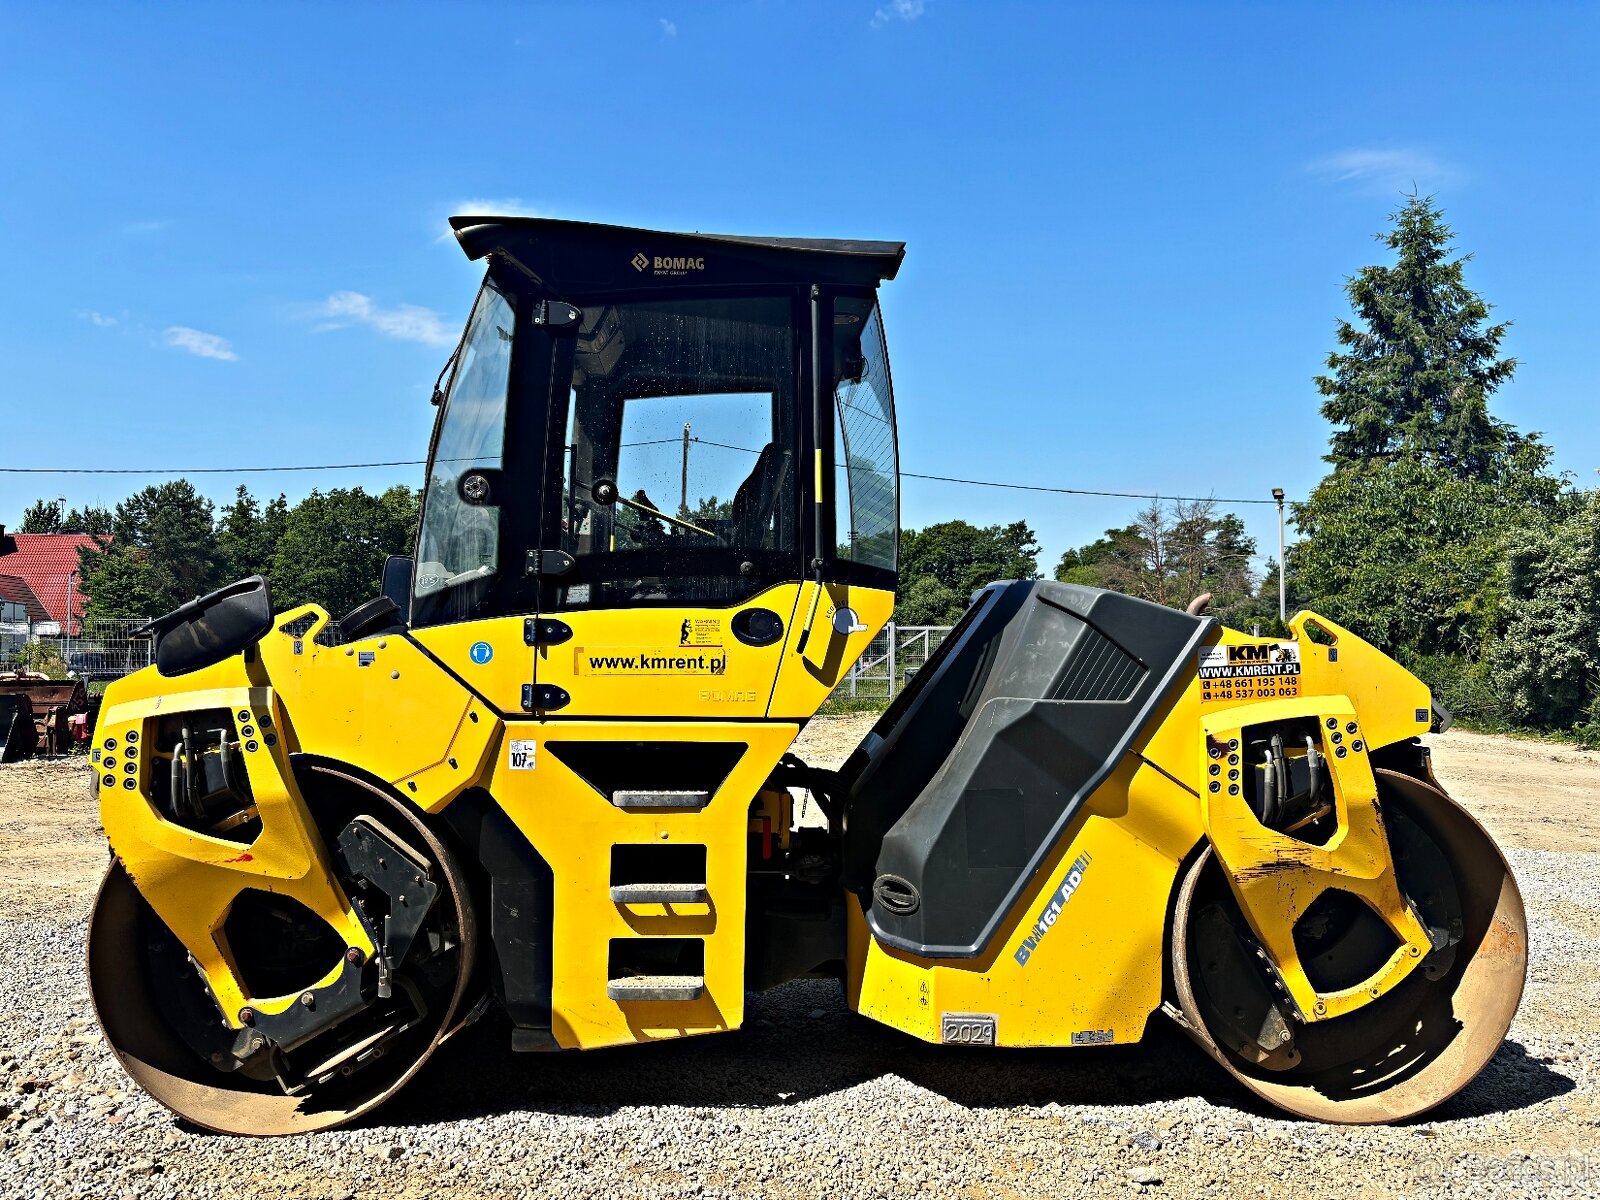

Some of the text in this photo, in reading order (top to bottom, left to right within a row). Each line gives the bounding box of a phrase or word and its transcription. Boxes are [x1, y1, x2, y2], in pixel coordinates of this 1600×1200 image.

[654, 256, 705, 270] BOMAG
[1229, 645, 1268, 661] KM
[589, 654, 726, 673] www.kmrent.pl
[1199, 664, 1300, 678] WWW.KMRENT.PL
[1213, 676, 1297, 688] +48 661 195 148
[700, 690, 757, 702] BOMAG
[1213, 687, 1297, 699] +48 537 003 063
[511, 752, 527, 767] 107
[1039, 901, 1063, 933] 161
[1061, 870, 1082, 903] AD
